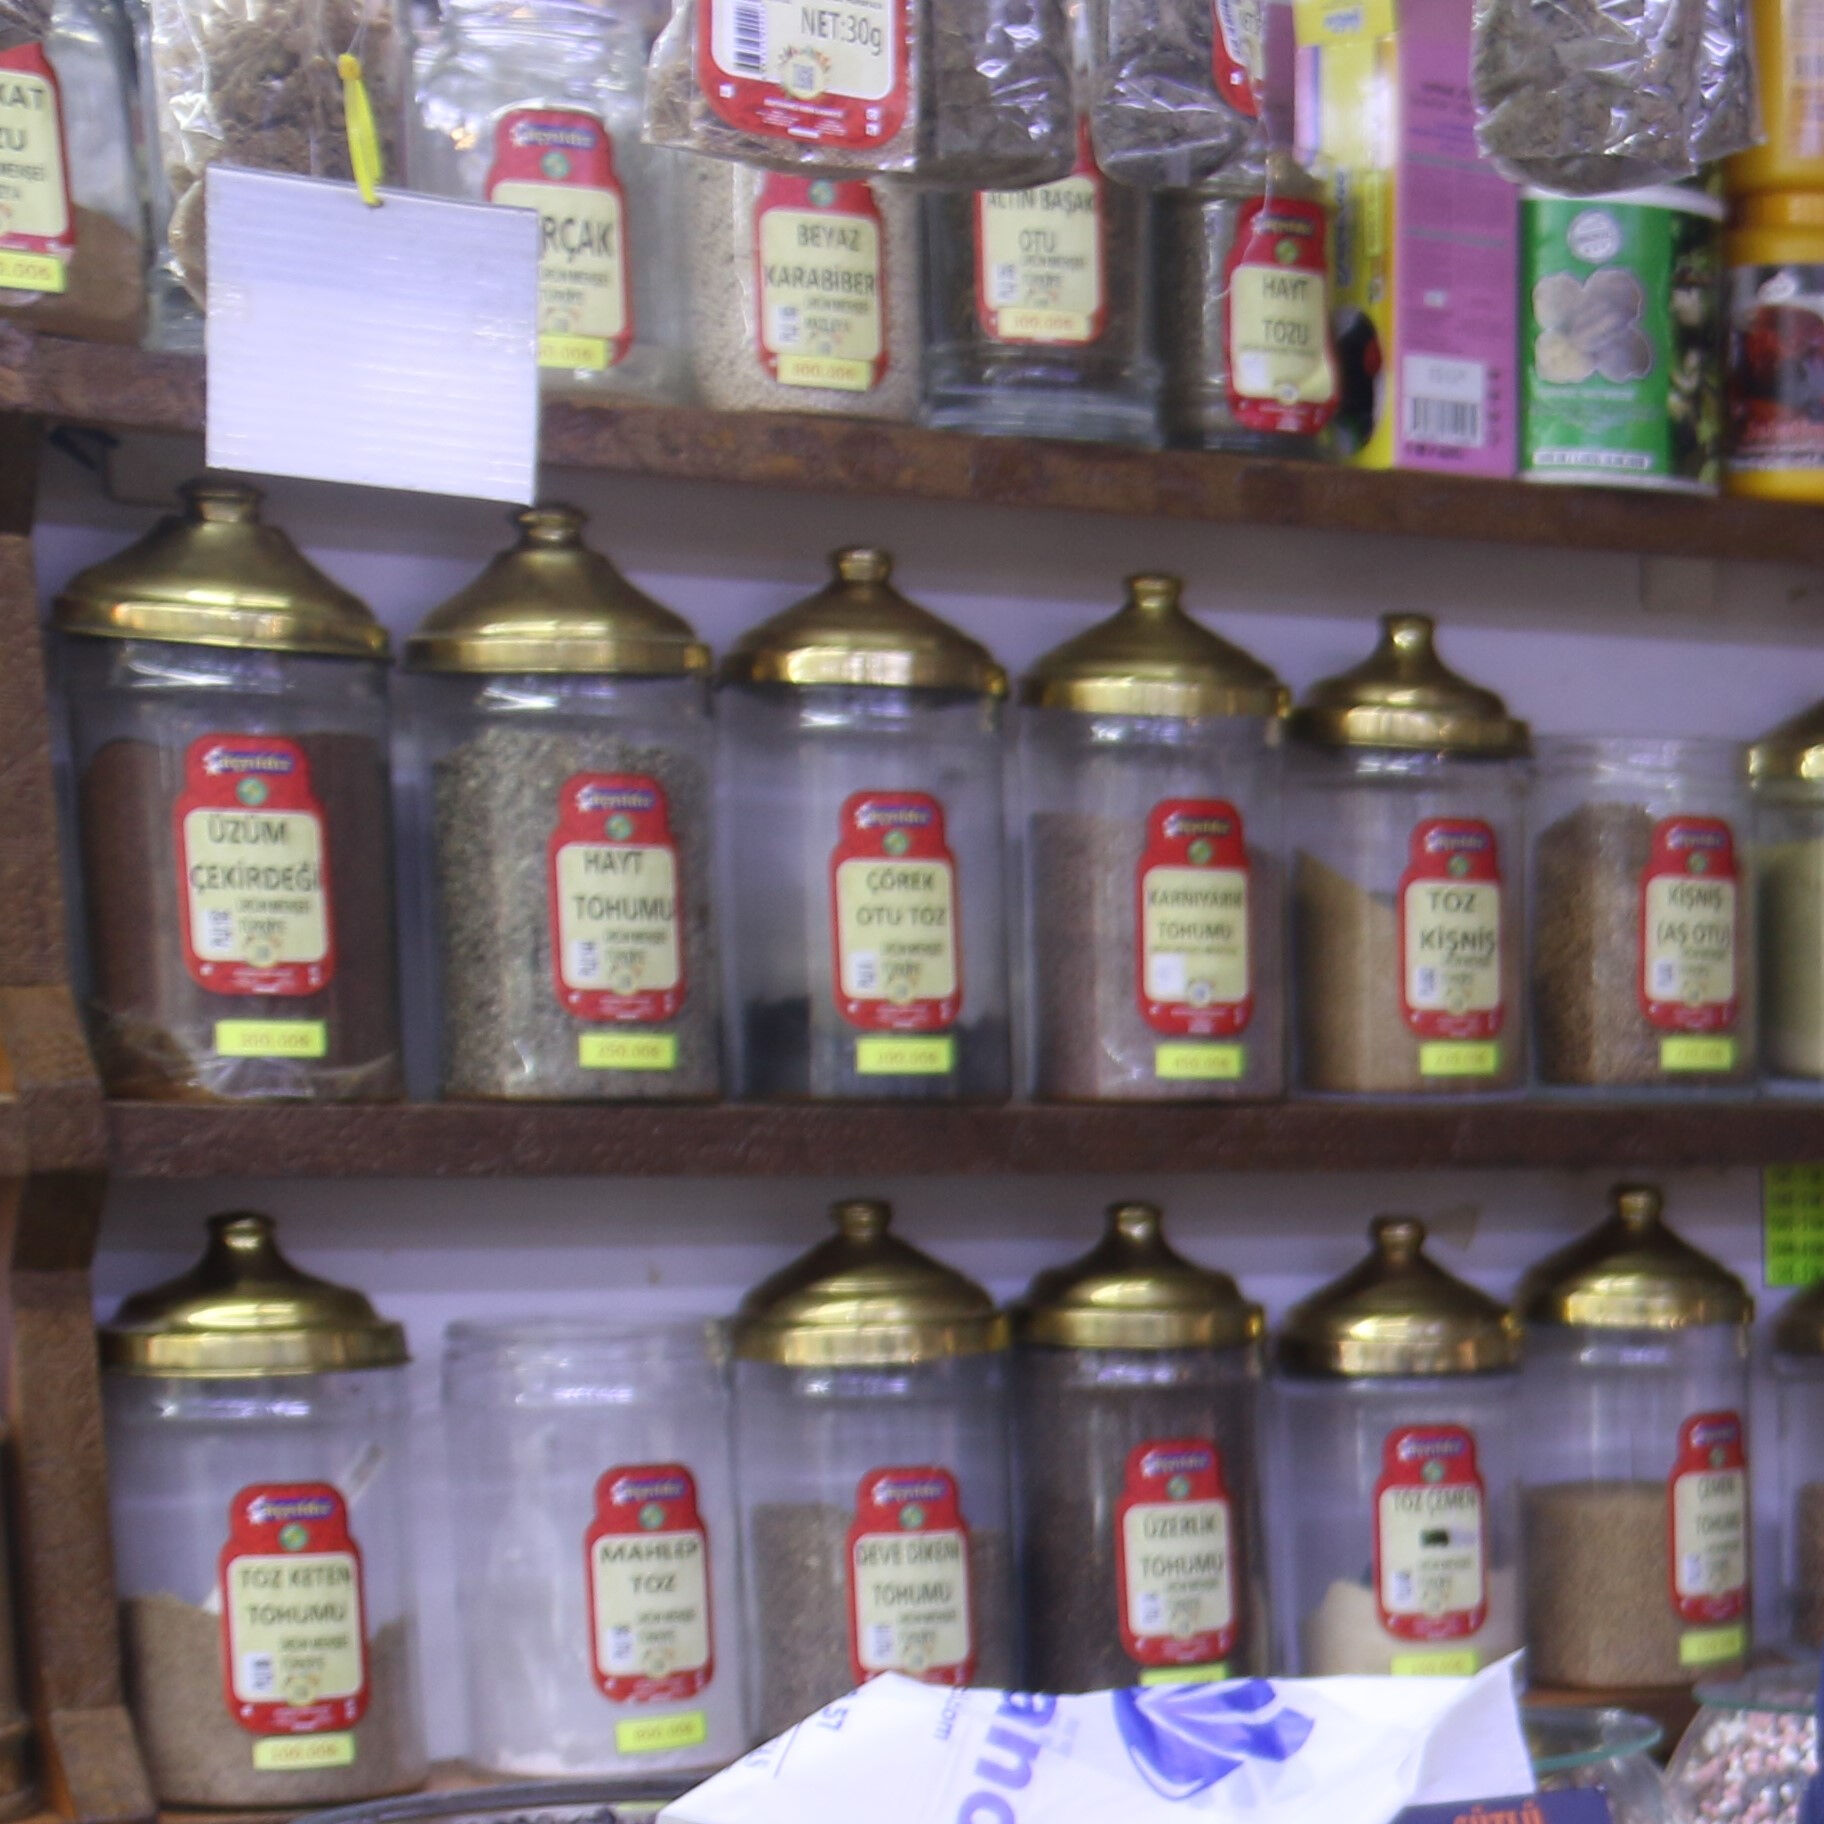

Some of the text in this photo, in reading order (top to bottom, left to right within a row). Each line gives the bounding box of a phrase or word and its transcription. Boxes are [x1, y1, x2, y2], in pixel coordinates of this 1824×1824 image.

[537, 216, 616, 263] RÇAK
[797, 223, 861, 253] BEYAZ
[208, 812, 289, 845] ÜZÜM
[573, 896, 676, 922] TOHUMU
[1427, 889, 1478, 915] TOZ
